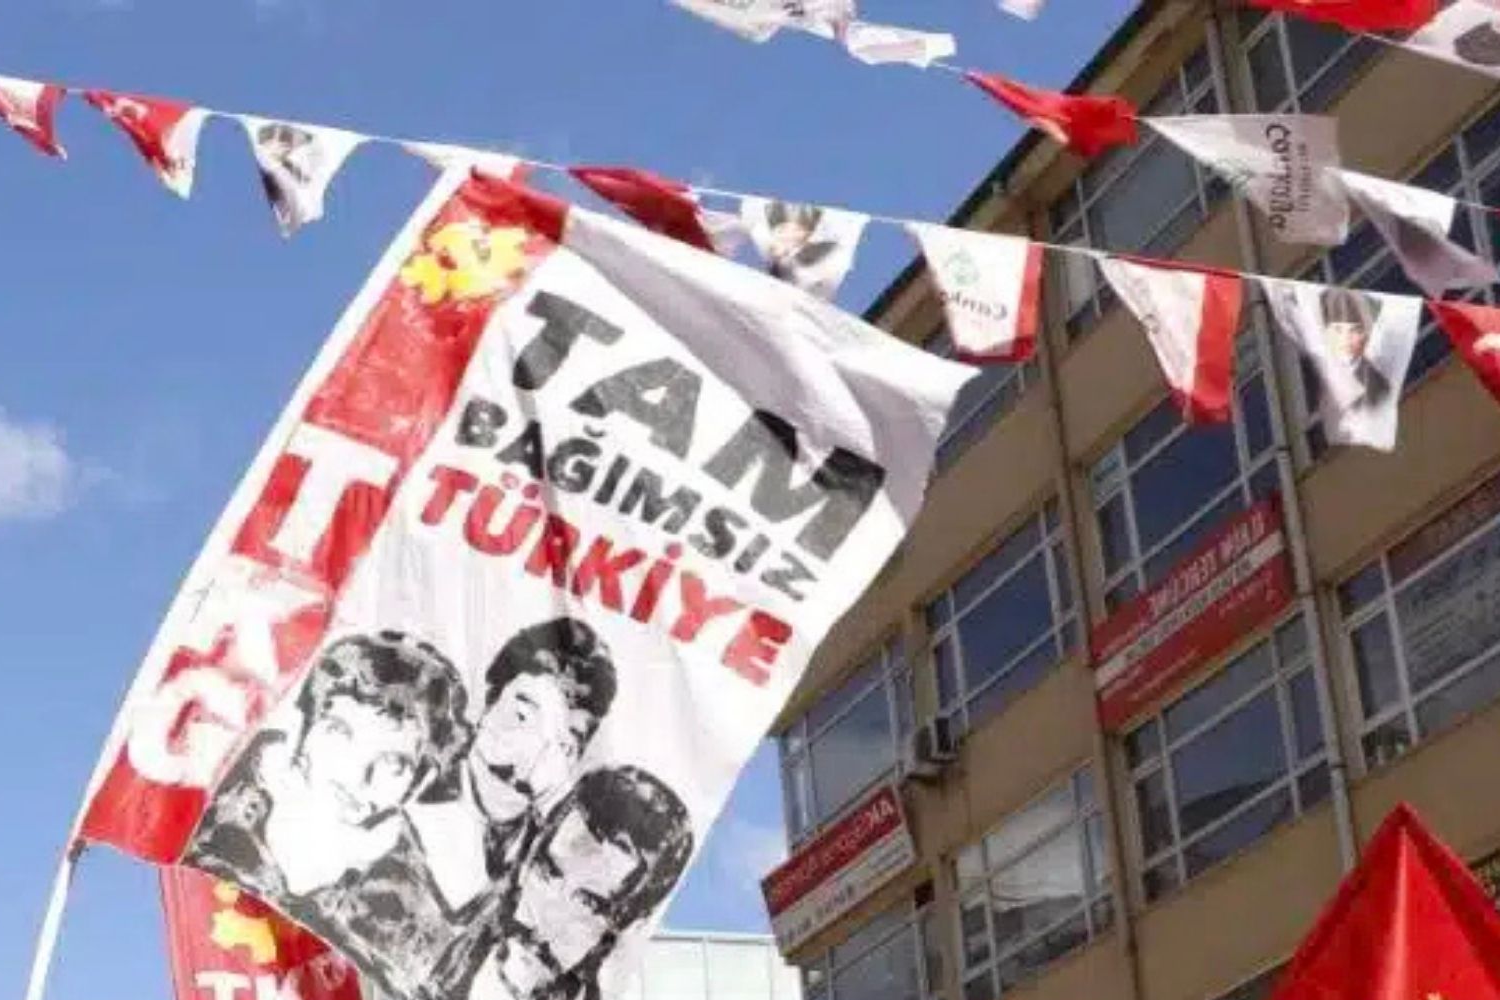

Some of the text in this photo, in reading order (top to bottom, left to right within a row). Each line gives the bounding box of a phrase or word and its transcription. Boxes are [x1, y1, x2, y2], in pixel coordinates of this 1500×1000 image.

[455, 397, 821, 602] BAĞIMSIZ
[512, 290, 886, 562] TAM
[418, 466, 794, 688] TÜRKİYE
